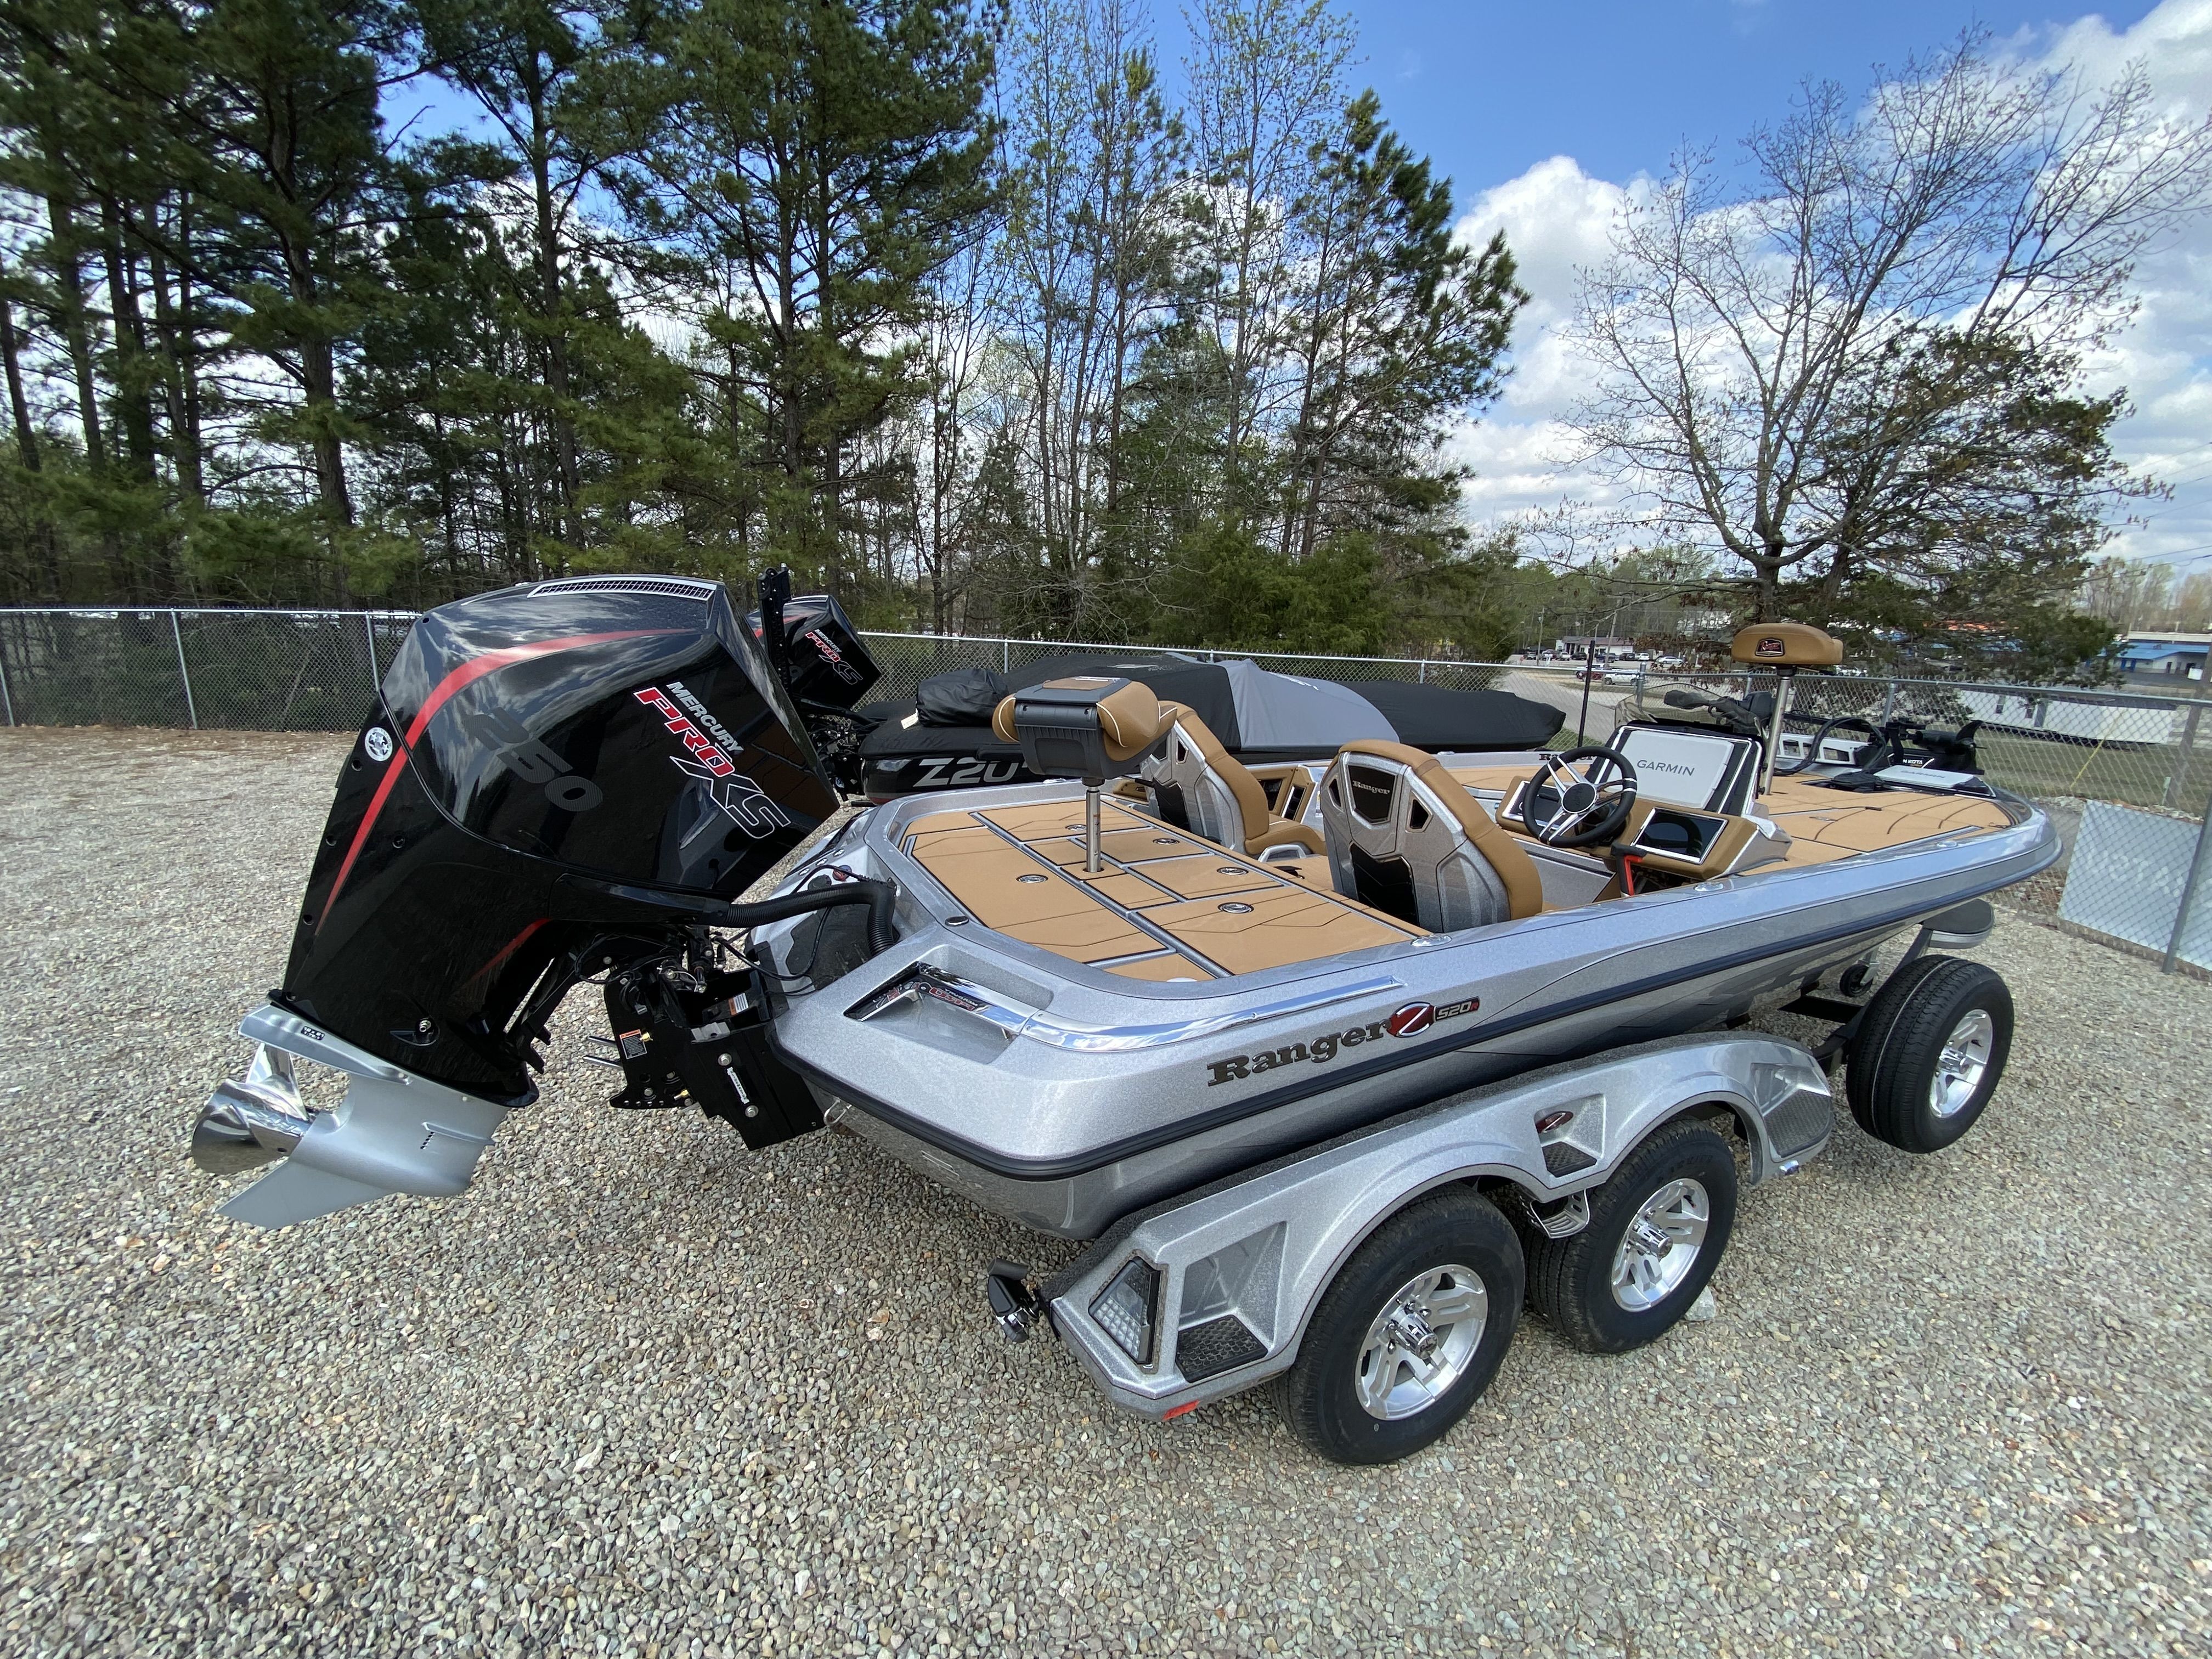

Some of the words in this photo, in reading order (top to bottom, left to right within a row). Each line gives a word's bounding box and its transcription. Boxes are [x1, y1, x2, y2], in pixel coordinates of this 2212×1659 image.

[805, 631, 840, 662] PRO
[815, 629, 842, 652] MERCURY
[819, 650, 863, 685] XS
[633, 687, 735, 777] PRO
[666, 681, 744, 752] MERCURY
[461, 707, 603, 812] 250
[1637, 759, 1695, 776] GARMIN
[669, 742, 791, 839] XS
[1352, 780, 1390, 794] Ranger
[1207, 1018, 1392, 1087] Ranger
